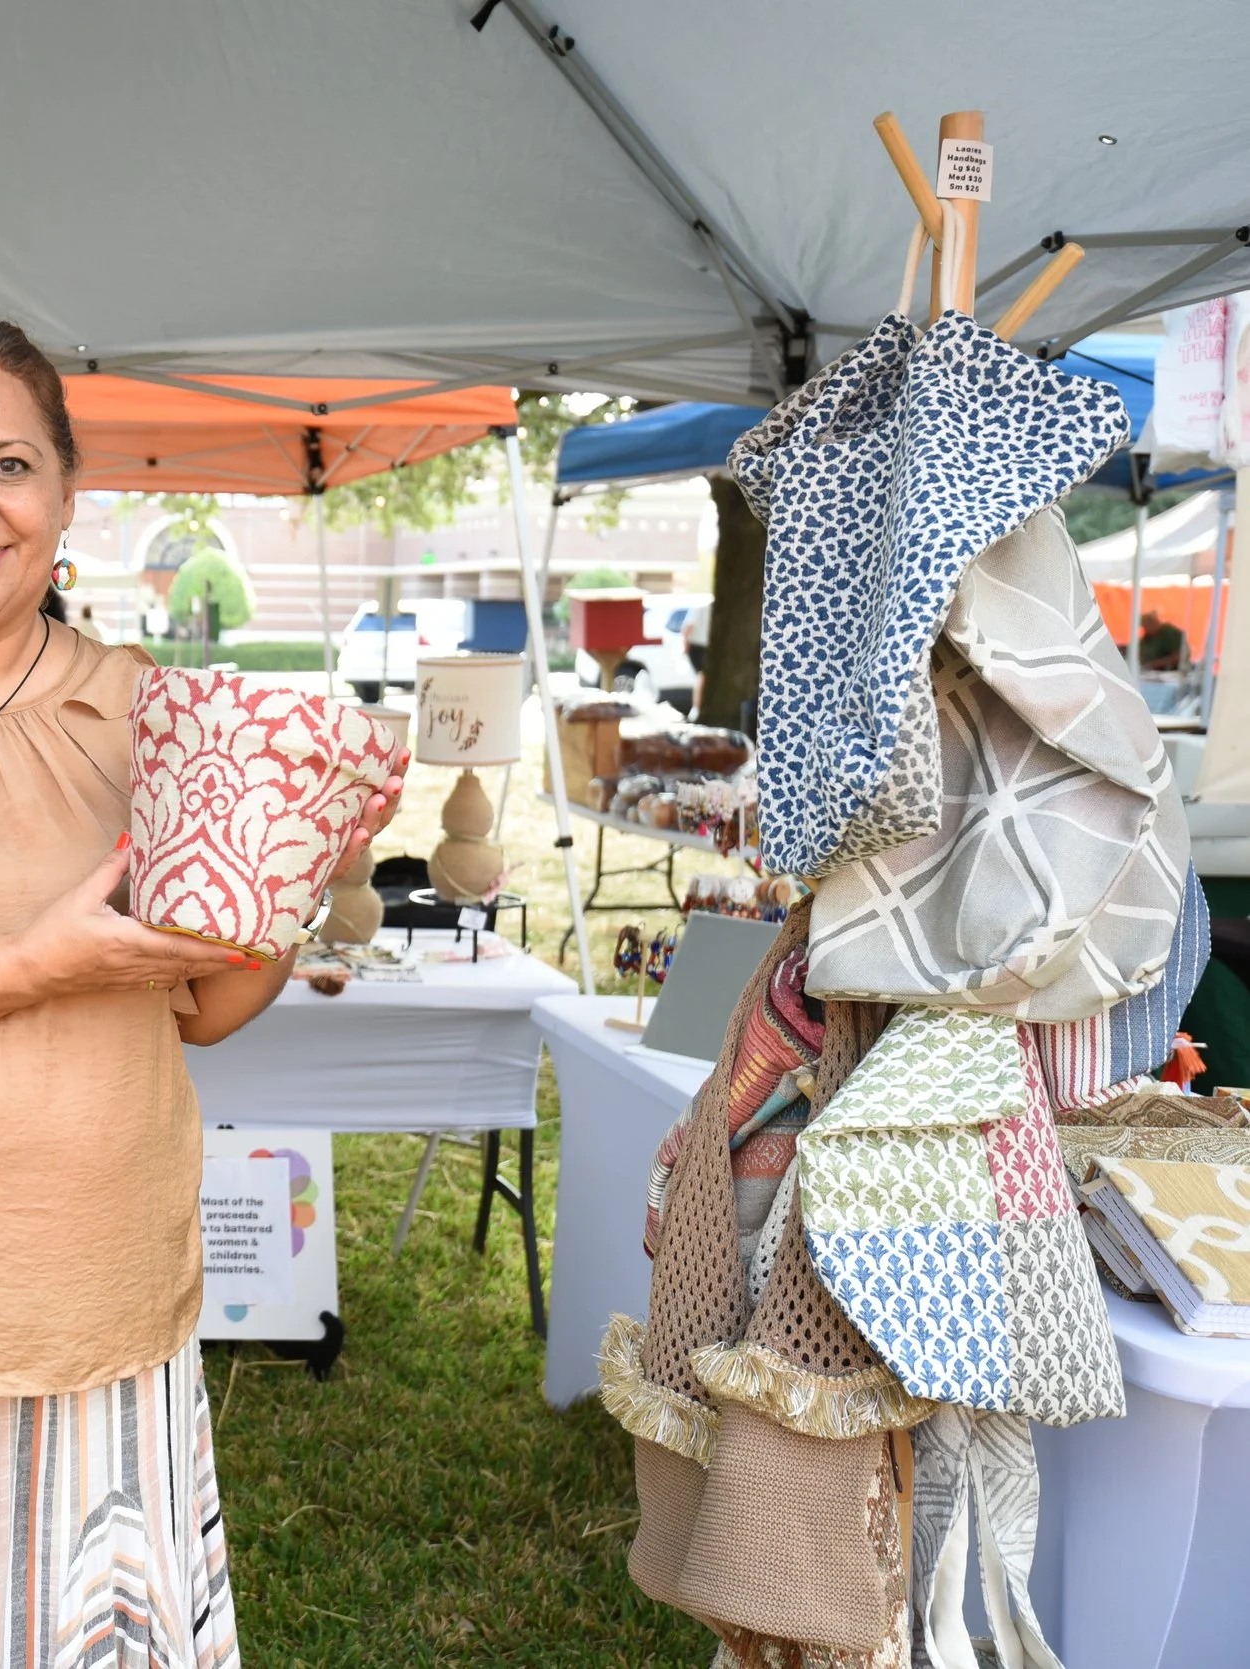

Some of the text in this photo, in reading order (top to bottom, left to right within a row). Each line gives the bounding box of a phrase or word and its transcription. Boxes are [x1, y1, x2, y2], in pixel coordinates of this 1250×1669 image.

[947, 153, 986, 165] Handbags
[953, 164, 981, 173] Lg $40
[948, 173, 982, 183] Med $30
[965, 184, 980, 192] $25
[427, 704, 464, 742] joy
[201, 1197, 264, 1206] Most of the
[206, 1210, 259, 1220] proceeds
[209, 1224, 221, 1233] to
[223, 1223, 273, 1233] battered
[207, 1237, 259, 1247] women &
[209, 1250, 257, 1260] children
[203, 1264, 265, 1274] ministries.
